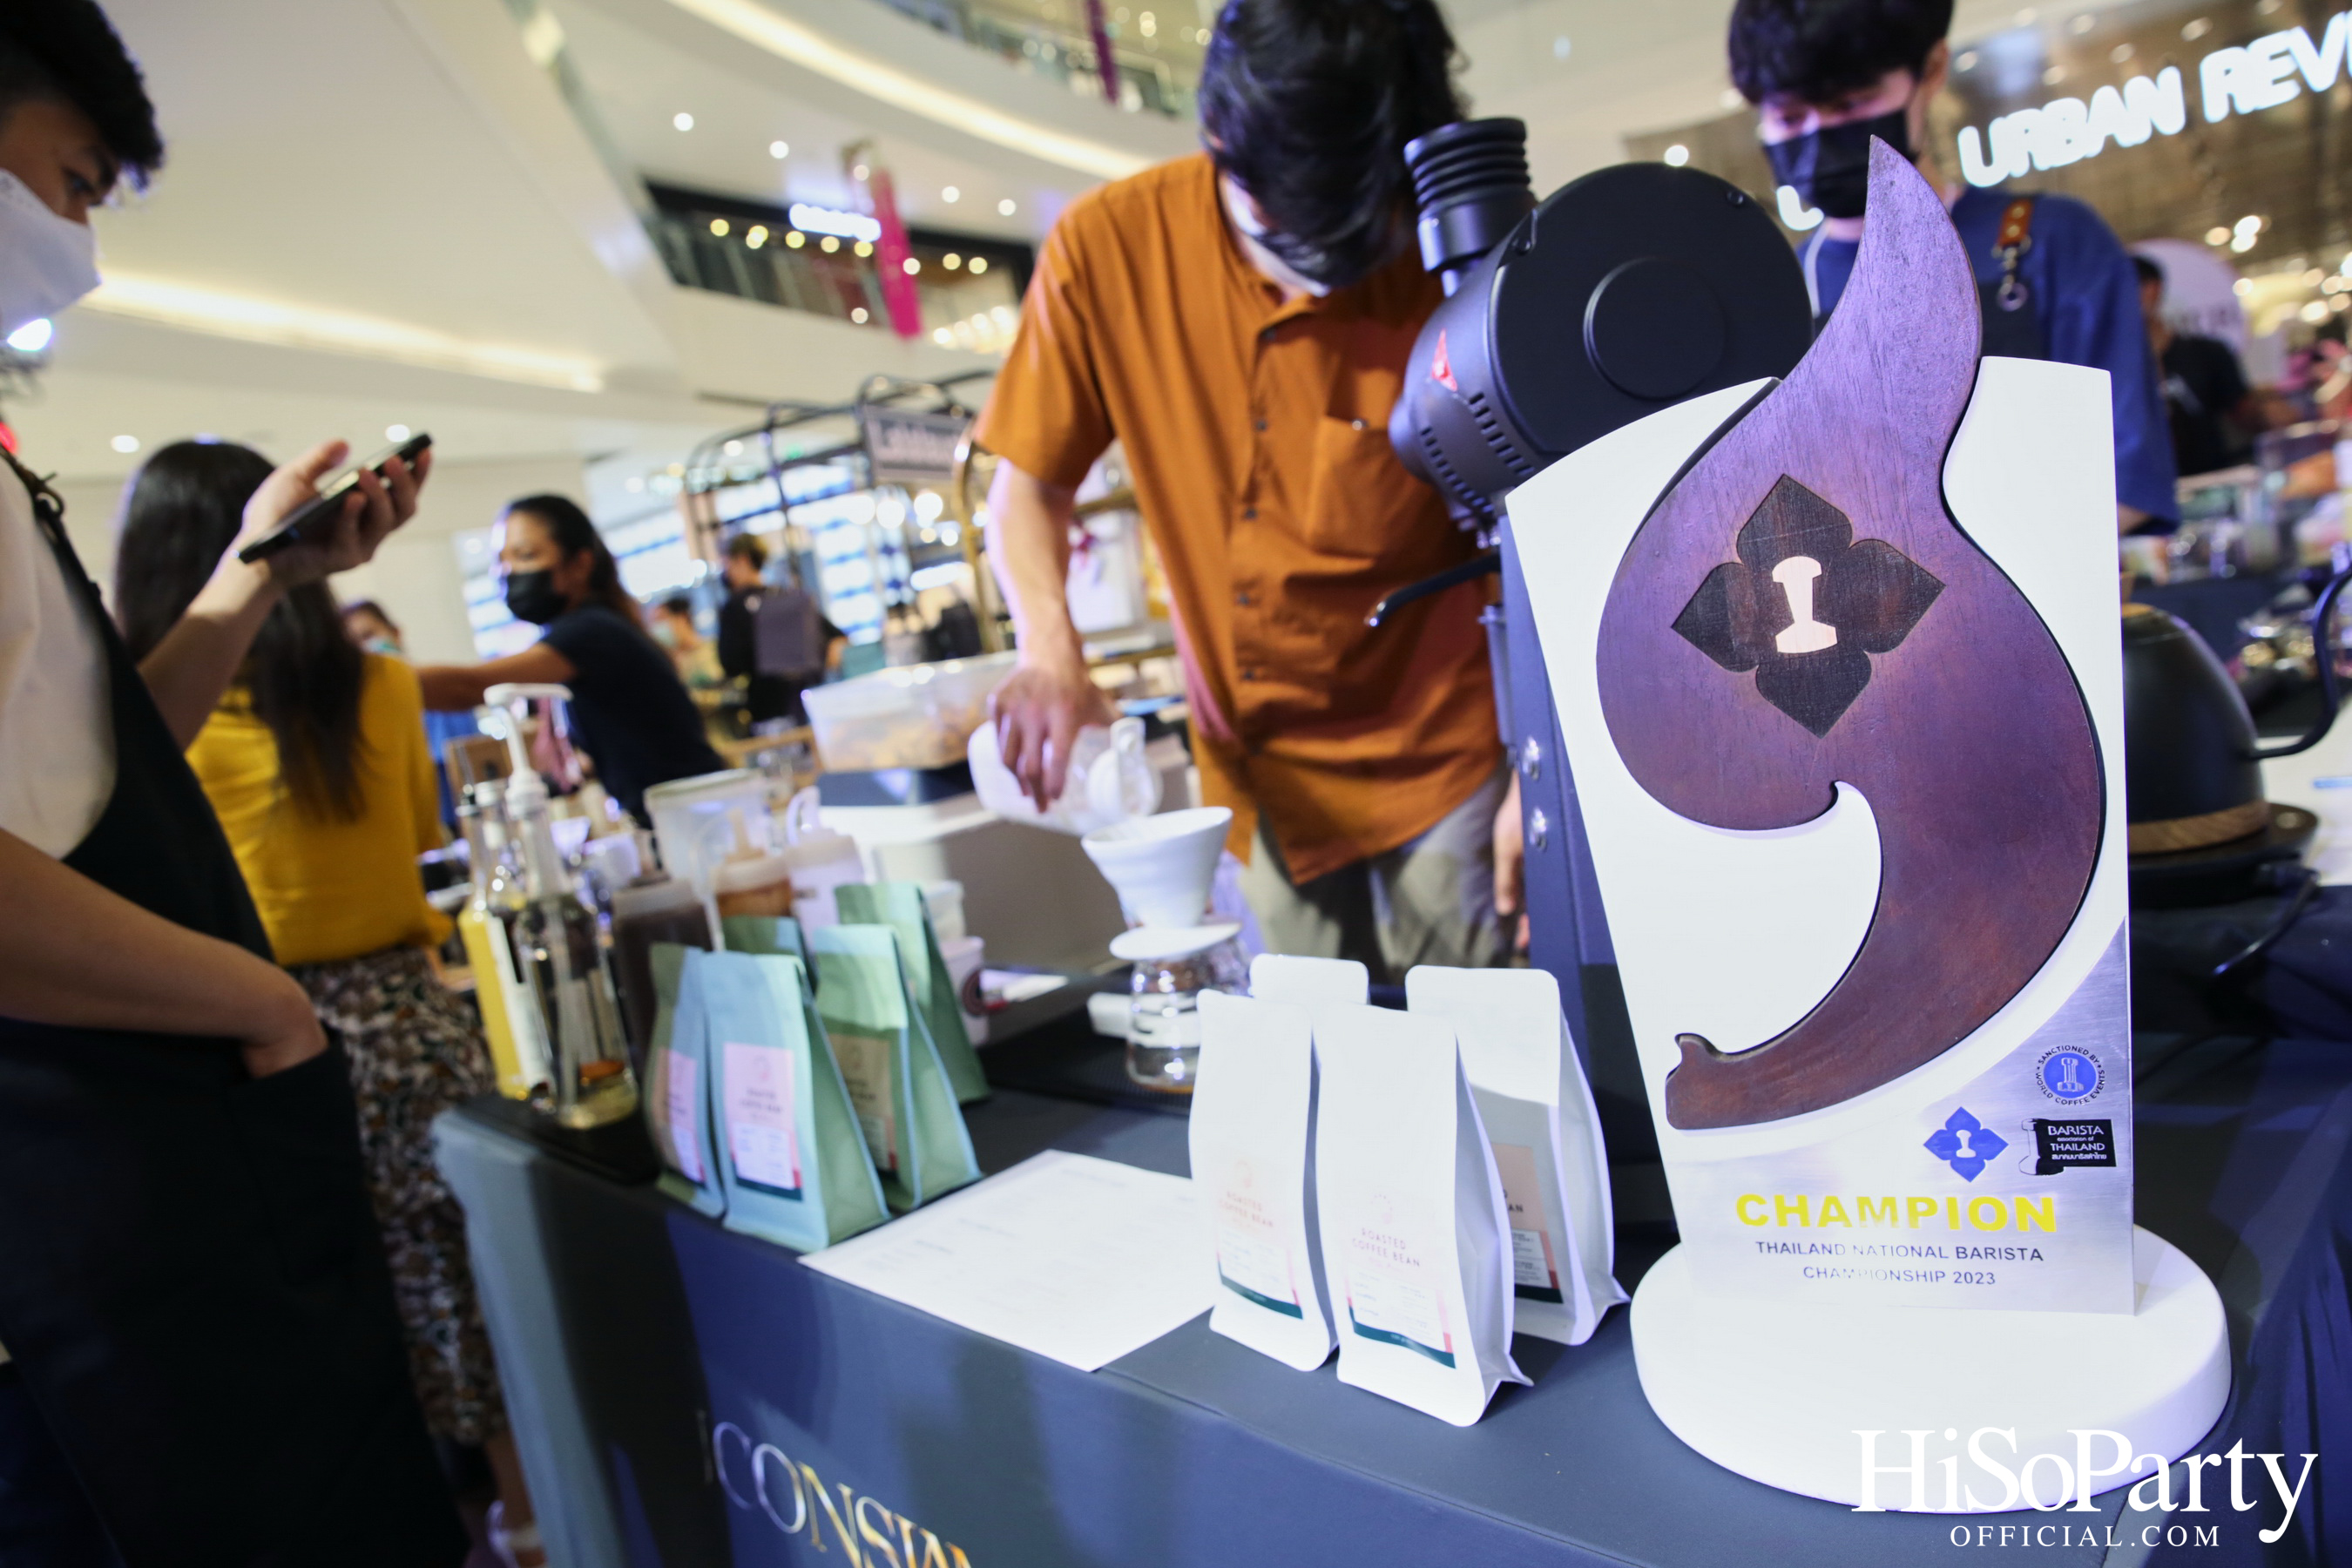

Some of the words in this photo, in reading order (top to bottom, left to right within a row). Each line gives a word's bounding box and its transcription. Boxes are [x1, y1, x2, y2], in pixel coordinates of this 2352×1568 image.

[1957, 65, 2186, 187] URBAN
[2200, 10, 2352, 123] REV
[2038, 1044, 2090, 1064] SANCTIONED
[2089, 1054, 2100, 1064] BY
[2035, 1071, 2054, 1098] WORLD
[2055, 1097, 2091, 1105] COFFEE
[2089, 1070, 2105, 1099] EVENTS
[2047, 1125, 2105, 1135] BARISTA
[2050, 1143, 2105, 1152] THAILAND
[1735, 1193, 2058, 1233] CHAMPION
[1361, 1227, 1407, 1250] ROASTED
[1351, 1237, 1388, 1258] COFFEE
[1393, 1251, 1421, 1267] BEAN
[1755, 1240, 1846, 1256] THAILAND
[1853, 1244, 1950, 1260] NATIONAL
[1955, 1246, 2044, 1261] BARISTA
[1802, 1266, 1946, 1283] CHAMPIONSHIP
[1953, 1270, 1996, 1285] 2023
